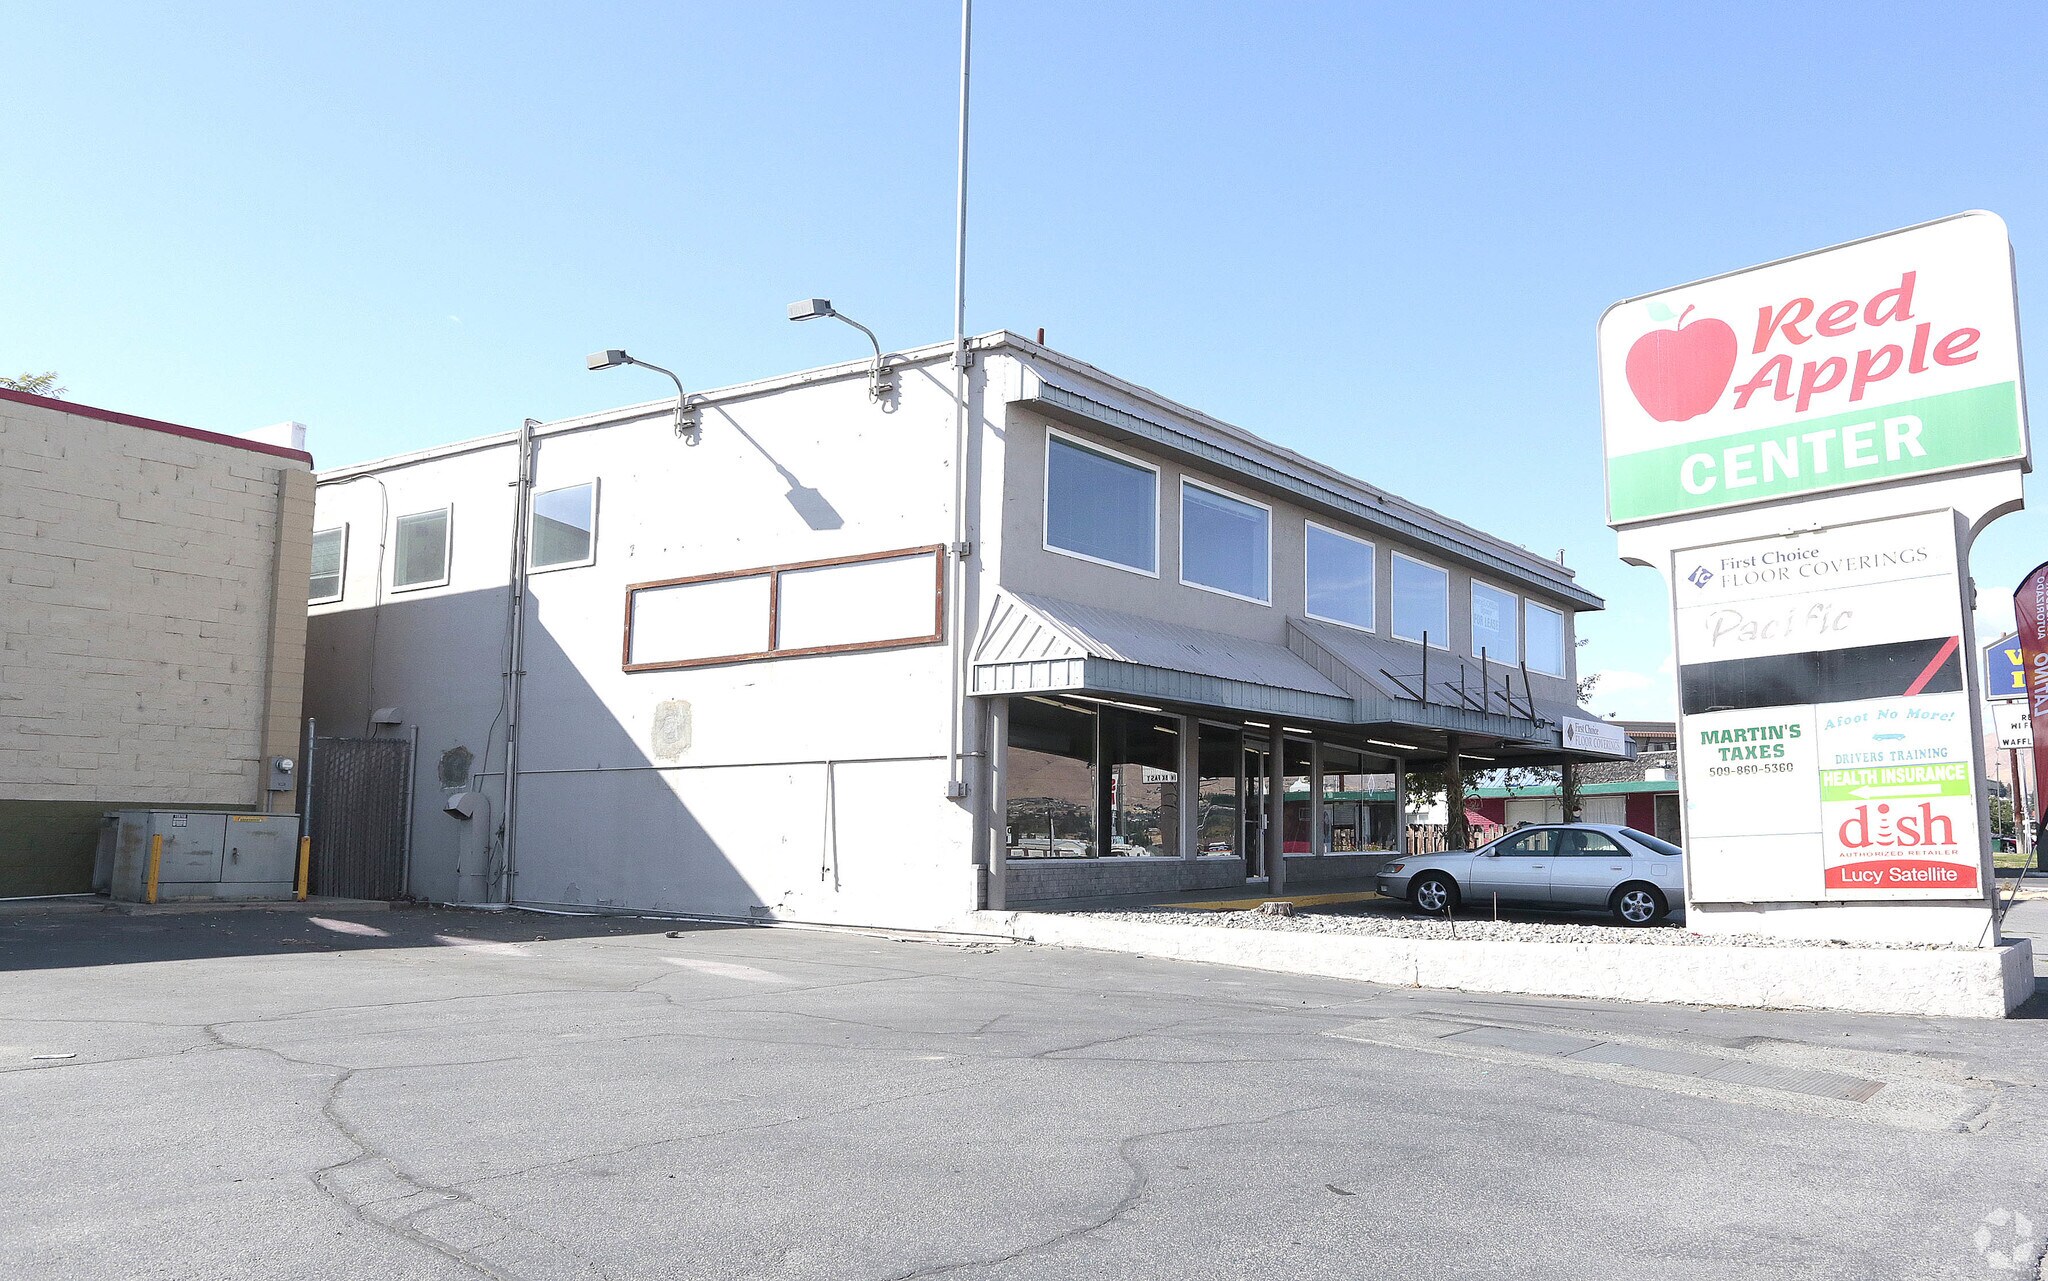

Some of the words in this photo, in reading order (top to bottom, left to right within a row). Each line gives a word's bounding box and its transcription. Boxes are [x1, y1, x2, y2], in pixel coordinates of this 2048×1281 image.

[1752, 270, 1917, 354] Red
[1732, 322, 1981, 413] Apple
[1680, 414, 1928, 495] CENTER
[1720, 556, 1757, 571] First
[1761, 547, 1820, 565] Choice
[1721, 566, 1791, 588] FLOOR
[1798, 546, 1929, 578] COVERINGS
[1575, 722, 1585, 733] First
[1585, 724, 1599, 735] Choice
[1824, 712, 1868, 730] Afoot
[1877, 708, 1898, 720] No
[1905, 708, 1955, 722] More!
[1575, 735, 1592, 747] FLOOR
[1593, 737, 1621, 751] COVERINGS
[1700, 723, 1802, 745] MARTIN'S
[1718, 743, 1785, 762] TAXES
[1889, 747, 1948, 762] TRAINING
[1709, 762, 1794, 778] 509-860-5360
[1823, 769, 1878, 787] HEALTH
[1881, 764, 1966, 784] INSURANCE
[1838, 802, 1957, 848] dish
[1841, 867, 1884, 885] Lucy
[1889, 866, 1958, 882] Satellite
